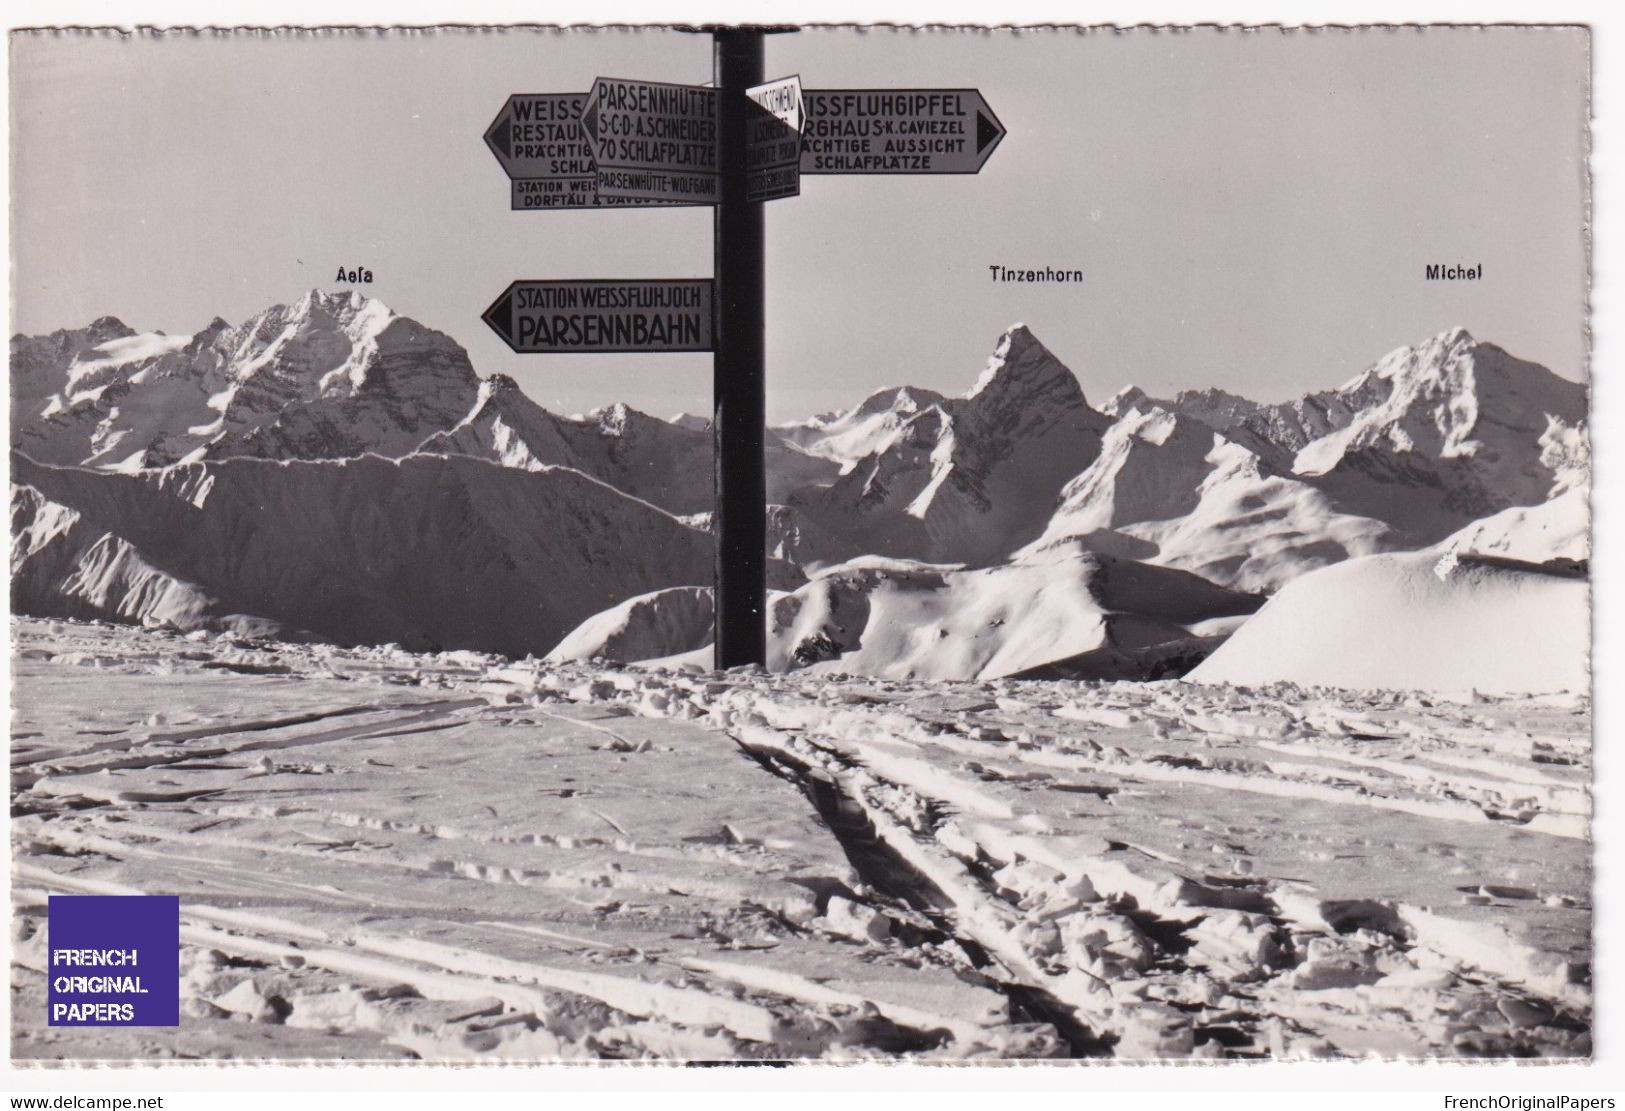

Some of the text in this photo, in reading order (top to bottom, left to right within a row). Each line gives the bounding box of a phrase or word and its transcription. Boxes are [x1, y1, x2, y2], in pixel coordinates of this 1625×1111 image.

[599, 82, 716, 118] PARSENNHÜTTE
[513, 124, 584, 142] RESTAU
[599, 138, 716, 166] 70 SCHLAFPLÄTZE
[884, 139, 965, 153] AUSSICHT
[814, 155, 931, 170] SCHLAFPLÄTZE
[517, 181, 563, 193] STATION
[517, 286, 701, 309] STATION WEISSFLUHJOCH
[519, 314, 701, 346] PARSENNBAHN
